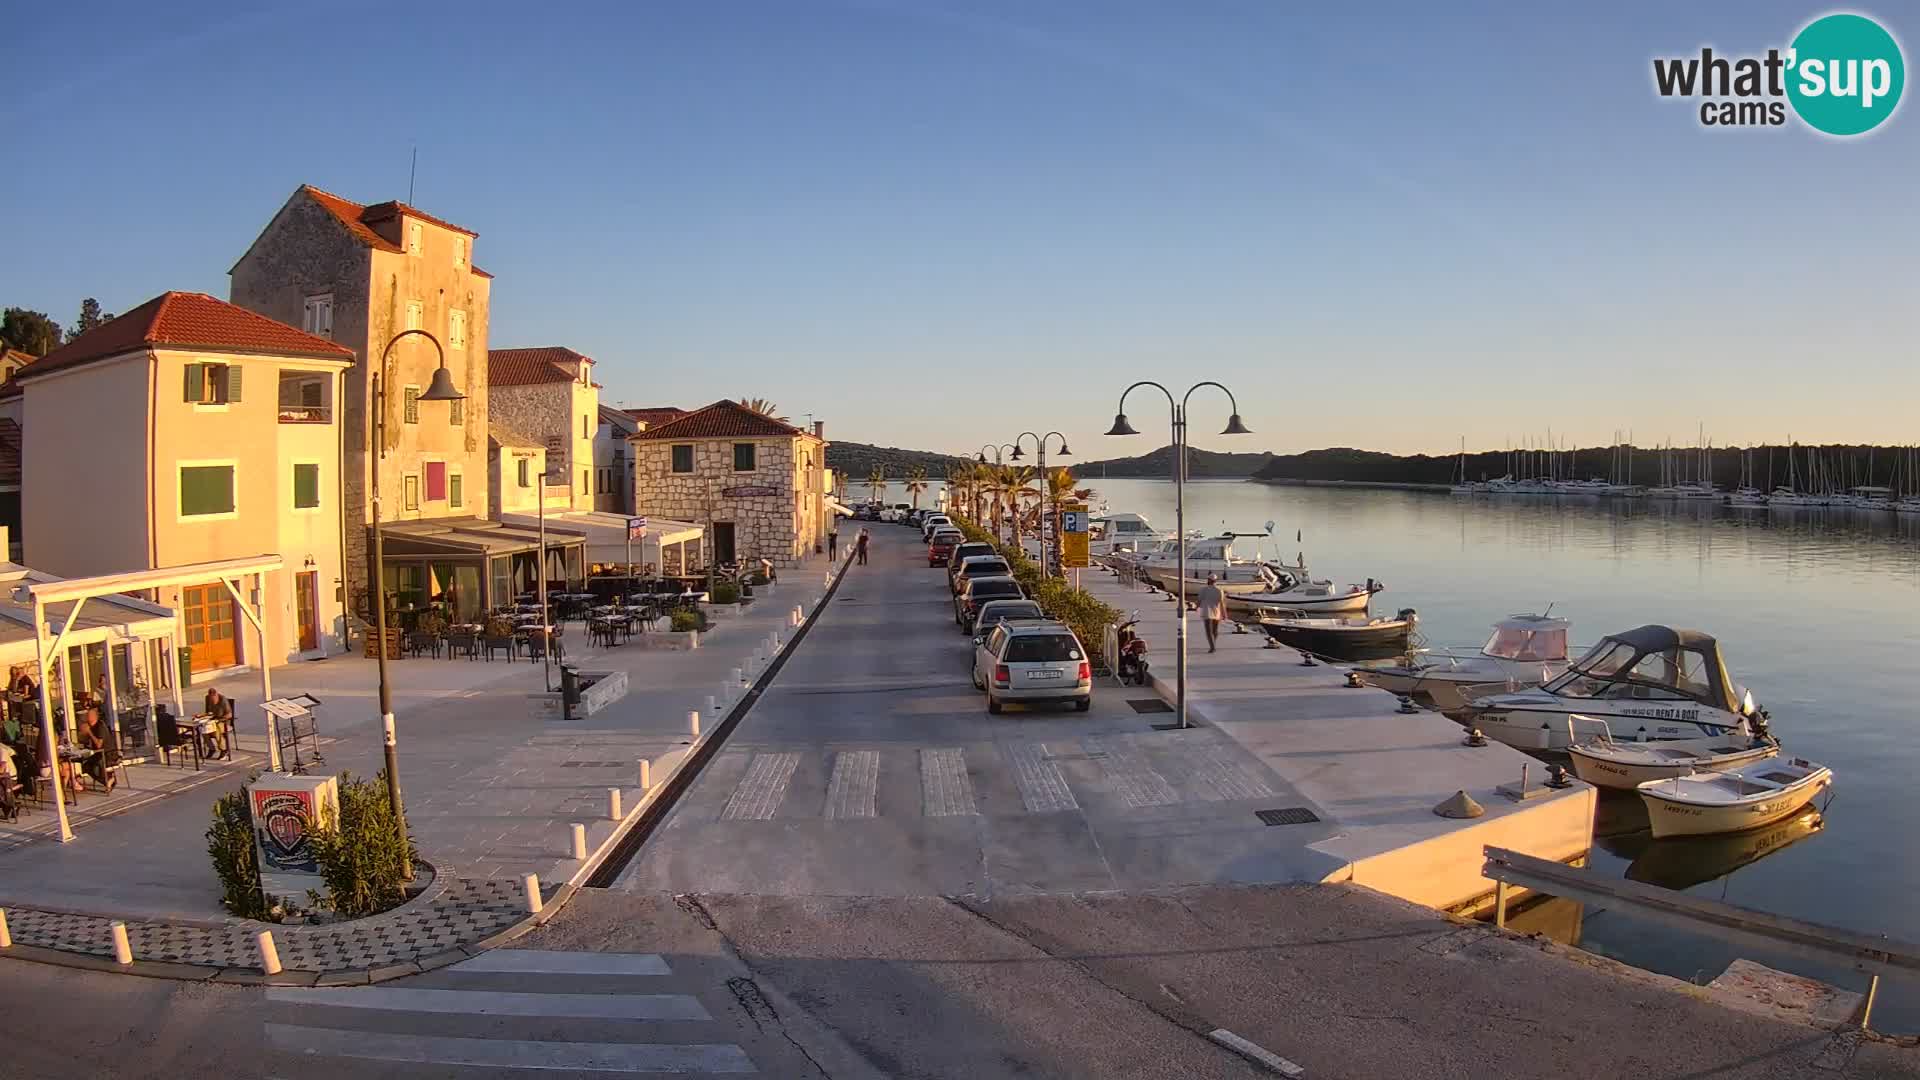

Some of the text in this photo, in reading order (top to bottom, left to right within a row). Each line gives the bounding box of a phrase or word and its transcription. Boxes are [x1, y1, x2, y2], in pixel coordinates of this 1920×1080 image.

[1065, 514, 1076, 529] P
[1656, 708, 1674, 719] RENT
[1681, 709, 1699, 720] BOAT
